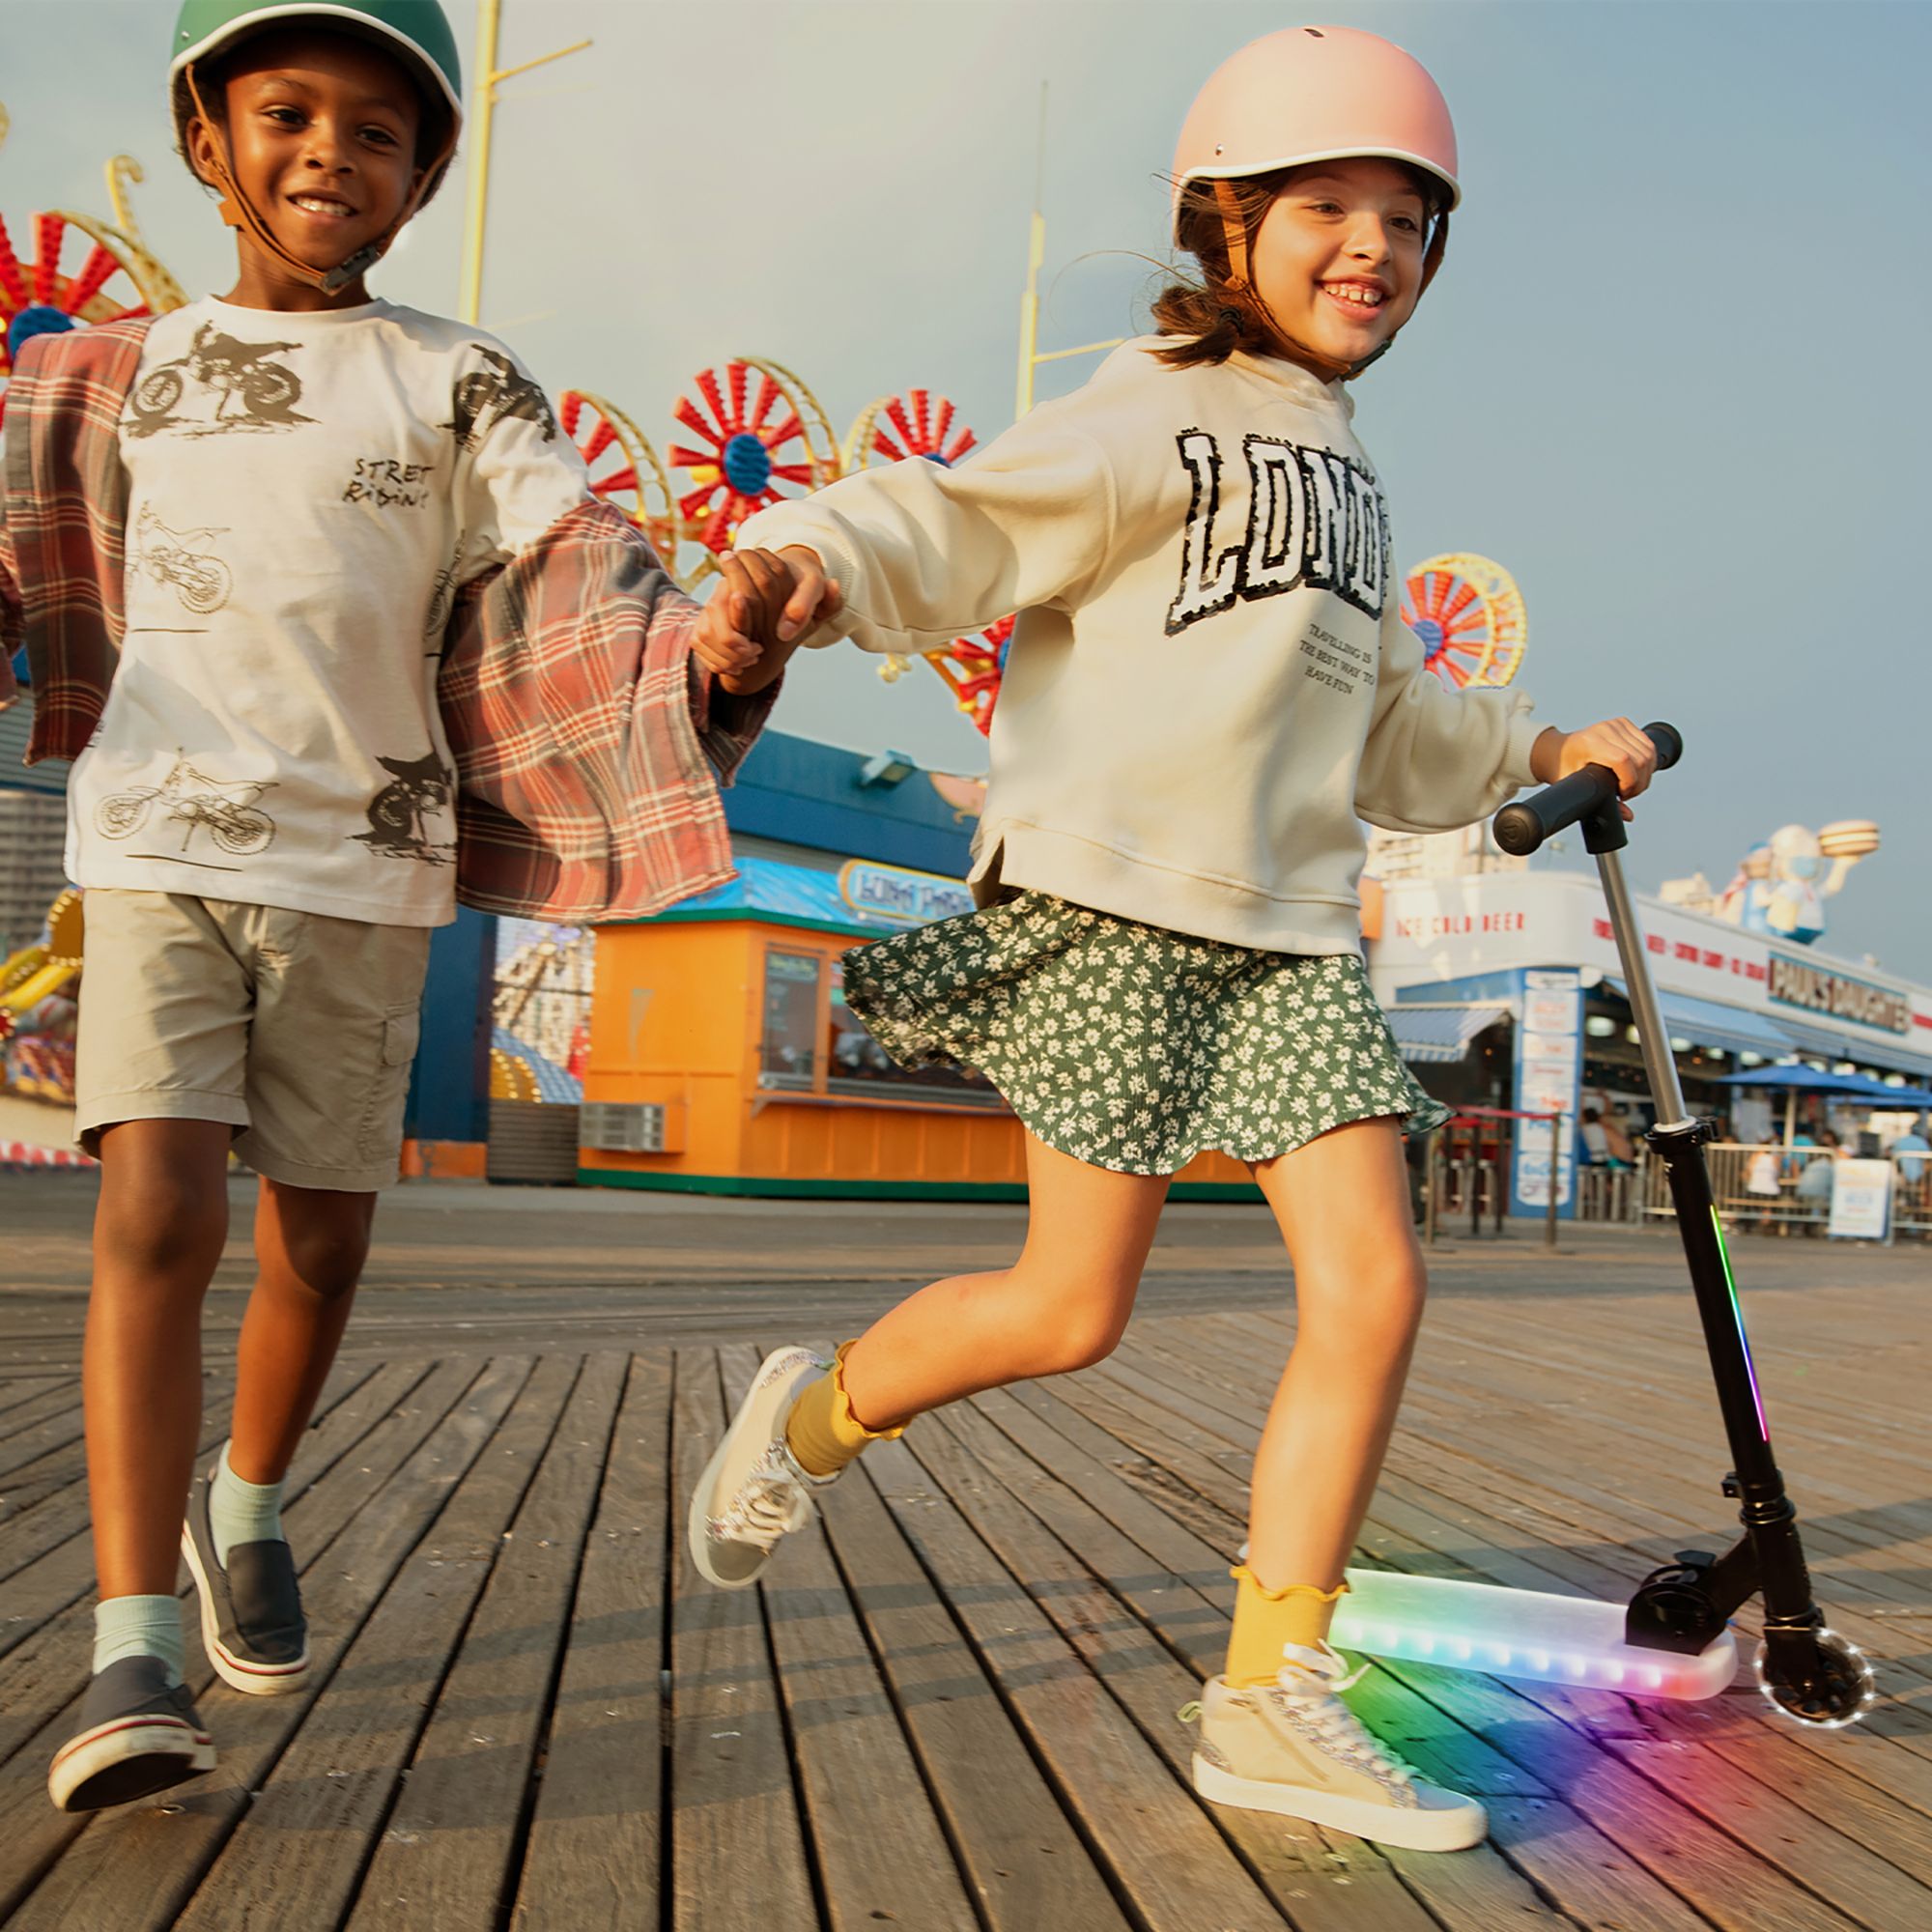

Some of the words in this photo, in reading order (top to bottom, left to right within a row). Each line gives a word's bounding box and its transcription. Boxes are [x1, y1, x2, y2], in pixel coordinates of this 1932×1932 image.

[1299, 639, 1316, 657] THE
[1316, 649, 1339, 668] BEST
[1340, 661, 1361, 678] WAY
[1363, 671, 1376, 685] TO
[1362, 652, 1372, 664] IS
